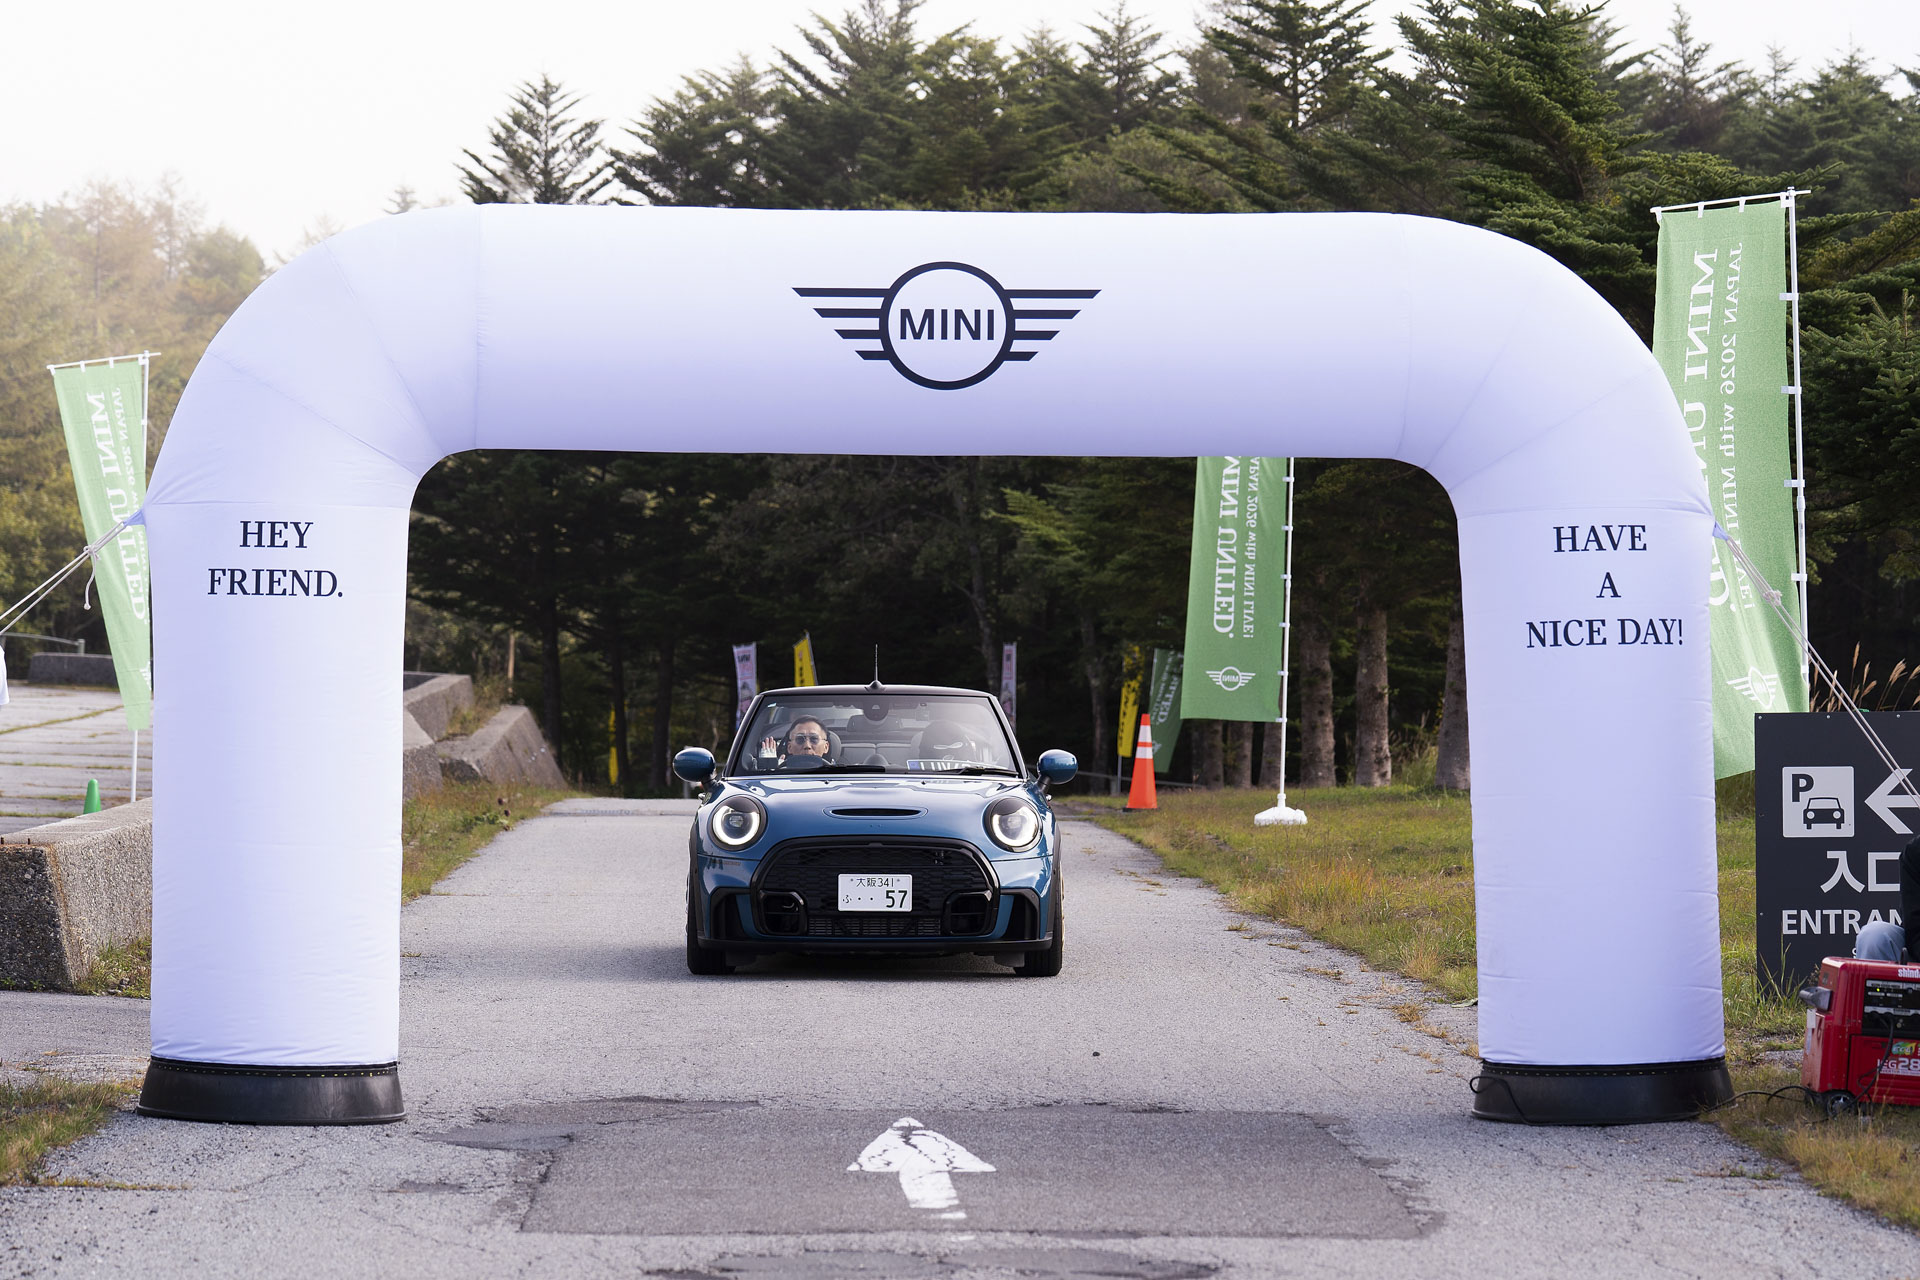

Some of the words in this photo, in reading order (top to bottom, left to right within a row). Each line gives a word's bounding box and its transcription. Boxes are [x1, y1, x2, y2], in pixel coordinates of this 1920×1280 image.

[899, 308, 995, 341] MINI
[239, 520, 314, 549] HEY
[1552, 524, 1647, 553] HAVE
[207, 568, 343, 598] FRIEND.
[1595, 571, 1622, 599] A
[1525, 618, 1607, 649] NICE
[1616, 618, 1683, 646] DAY!
